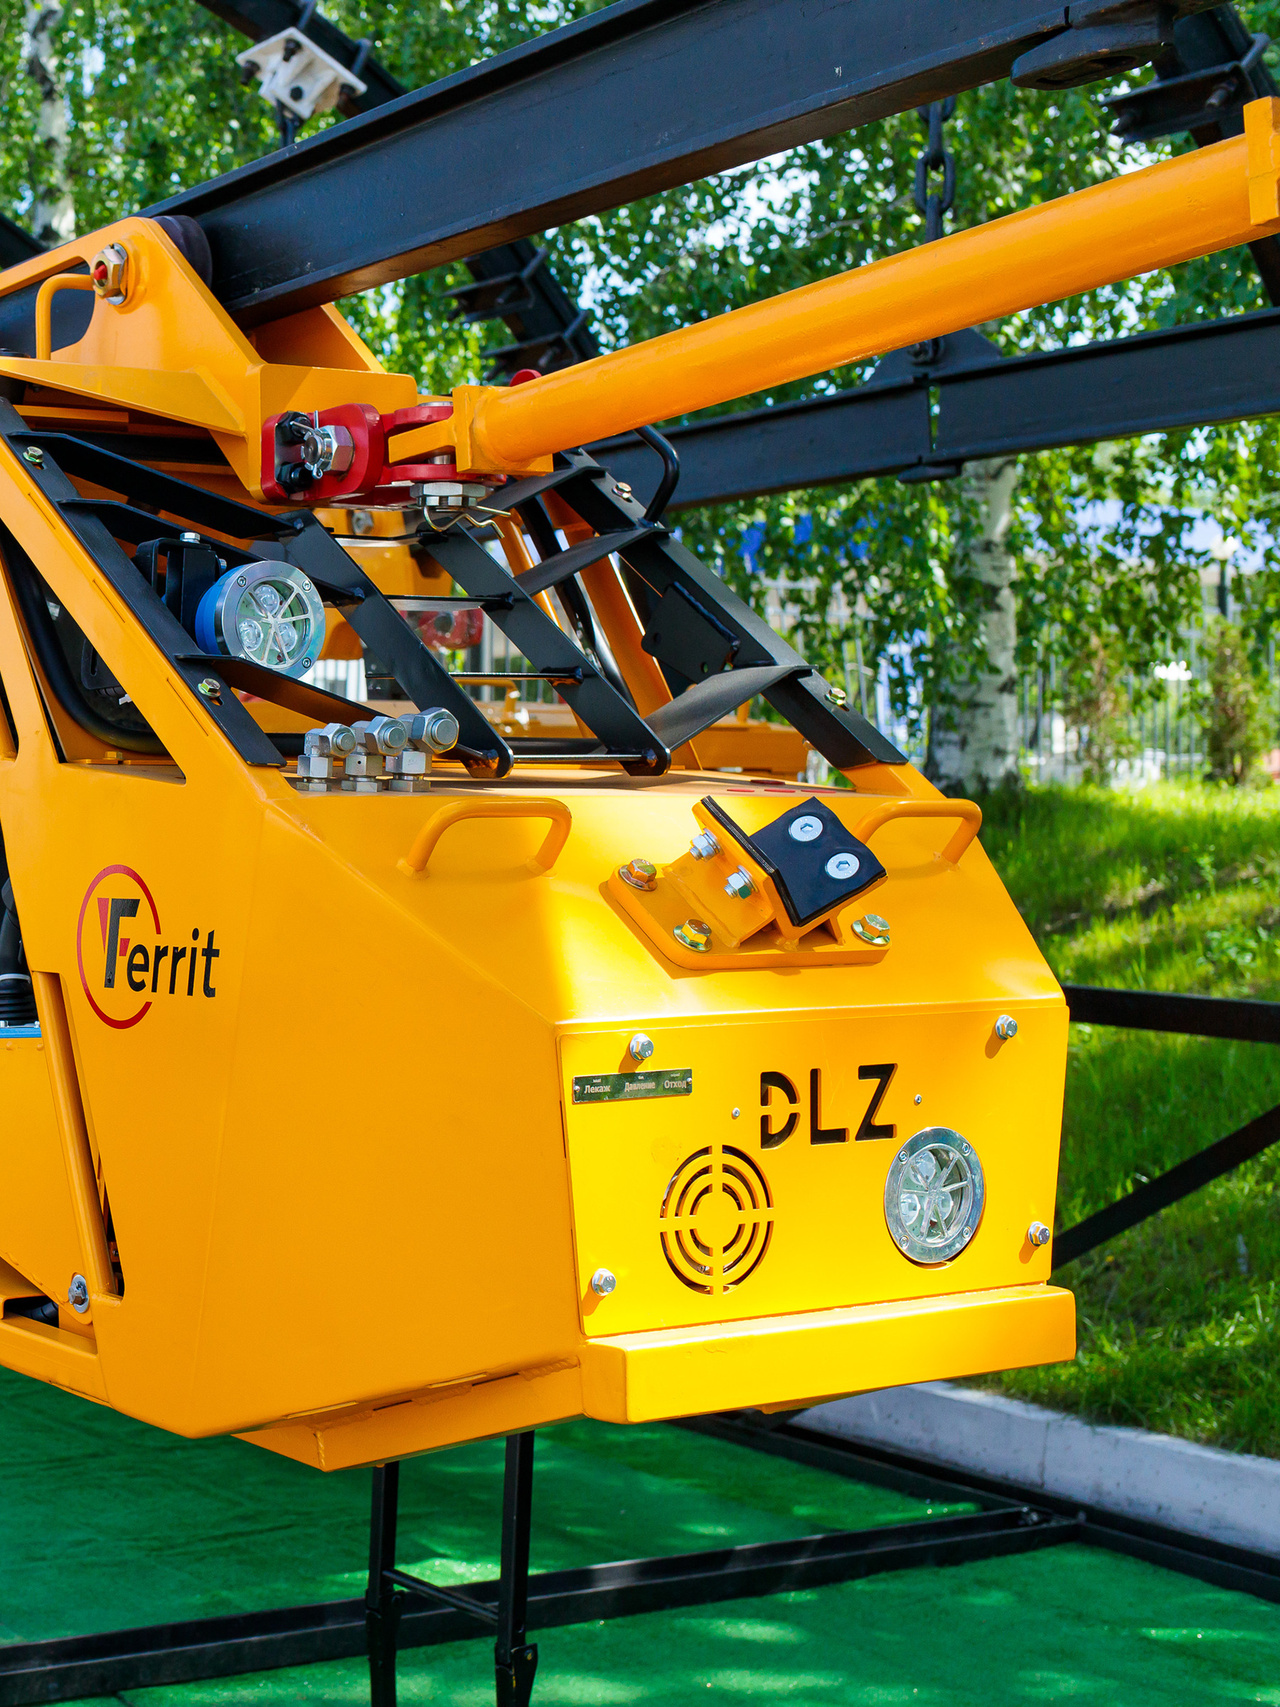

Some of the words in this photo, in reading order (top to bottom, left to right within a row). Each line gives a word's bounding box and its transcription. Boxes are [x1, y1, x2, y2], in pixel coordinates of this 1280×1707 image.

[97, 897, 220, 998] Ferrit
[624, 1082, 656, 1092] Давление
[663, 1079, 687, 1089] Отход
[760, 1063, 898, 1149] DLZ
